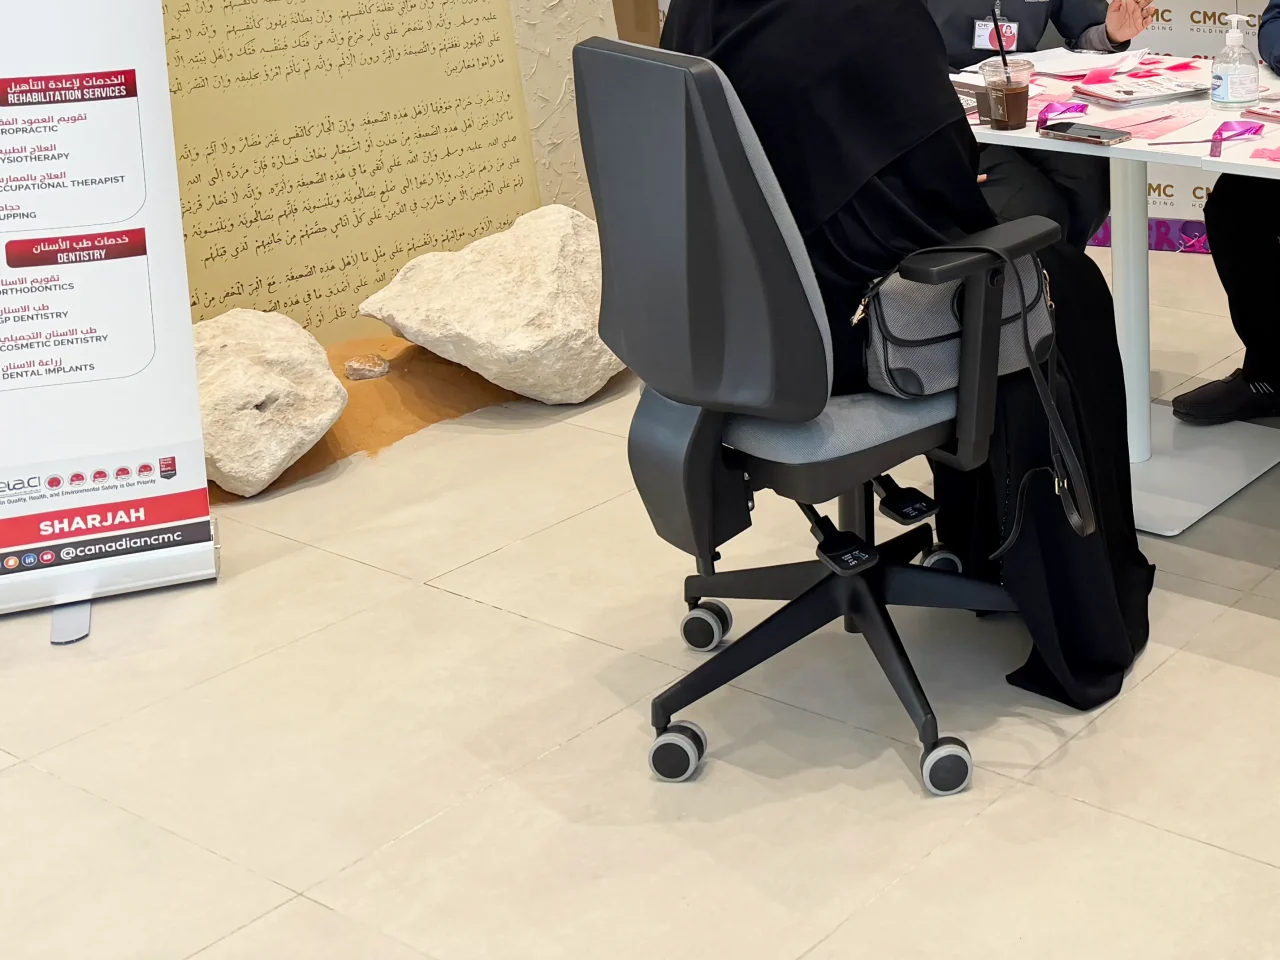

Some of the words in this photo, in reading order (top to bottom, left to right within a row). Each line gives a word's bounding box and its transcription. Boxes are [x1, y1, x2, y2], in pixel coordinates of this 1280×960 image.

[7, 79, 45, 93] التأهيل
[49, 78, 80, 89] لإعادة
[83, 75, 125, 86] الخدمات
[8, 89, 81, 104] REHABILITATION
[83, 86, 126, 99] SERVICES
[21, 116, 54, 126] العمود
[57, 113, 87, 124] تقويم
[0, 125, 58, 135] ROPRACTIC
[30, 144, 57, 155] العلاج
[0, 153, 70, 164] YSIOTHERAPY
[40, 171, 66, 183] العلاج
[70, 175, 126, 187] THERAPIST
[0, 212, 36, 221] UPPING
[72, 239, 91, 249] طب
[95, 235, 129, 246] خدمات
[32, 239, 69, 254] الأسنان
[57, 249, 106, 263] DENTISTRY
[30, 275, 60, 286] تقويم
[0, 283, 74, 296] RTHODONTICS
[33, 303, 50, 314] طب
[13, 311, 68, 323] DENTISTRY
[45, 328, 78, 340] الاسنان
[80, 327, 97, 338] طب
[0, 341, 50, 352] COSMETIC
[54, 334, 108, 347] DENTISTRY
[1, 360, 35, 373] الاسنان
[38, 358, 62, 369] زراعة
[2, 369, 43, 380] DENTAL
[45, 363, 95, 375] IMPLANTS
[39, 507, 145, 535] SHARJAH
[60, 531, 182, 560] @canadiancmc
